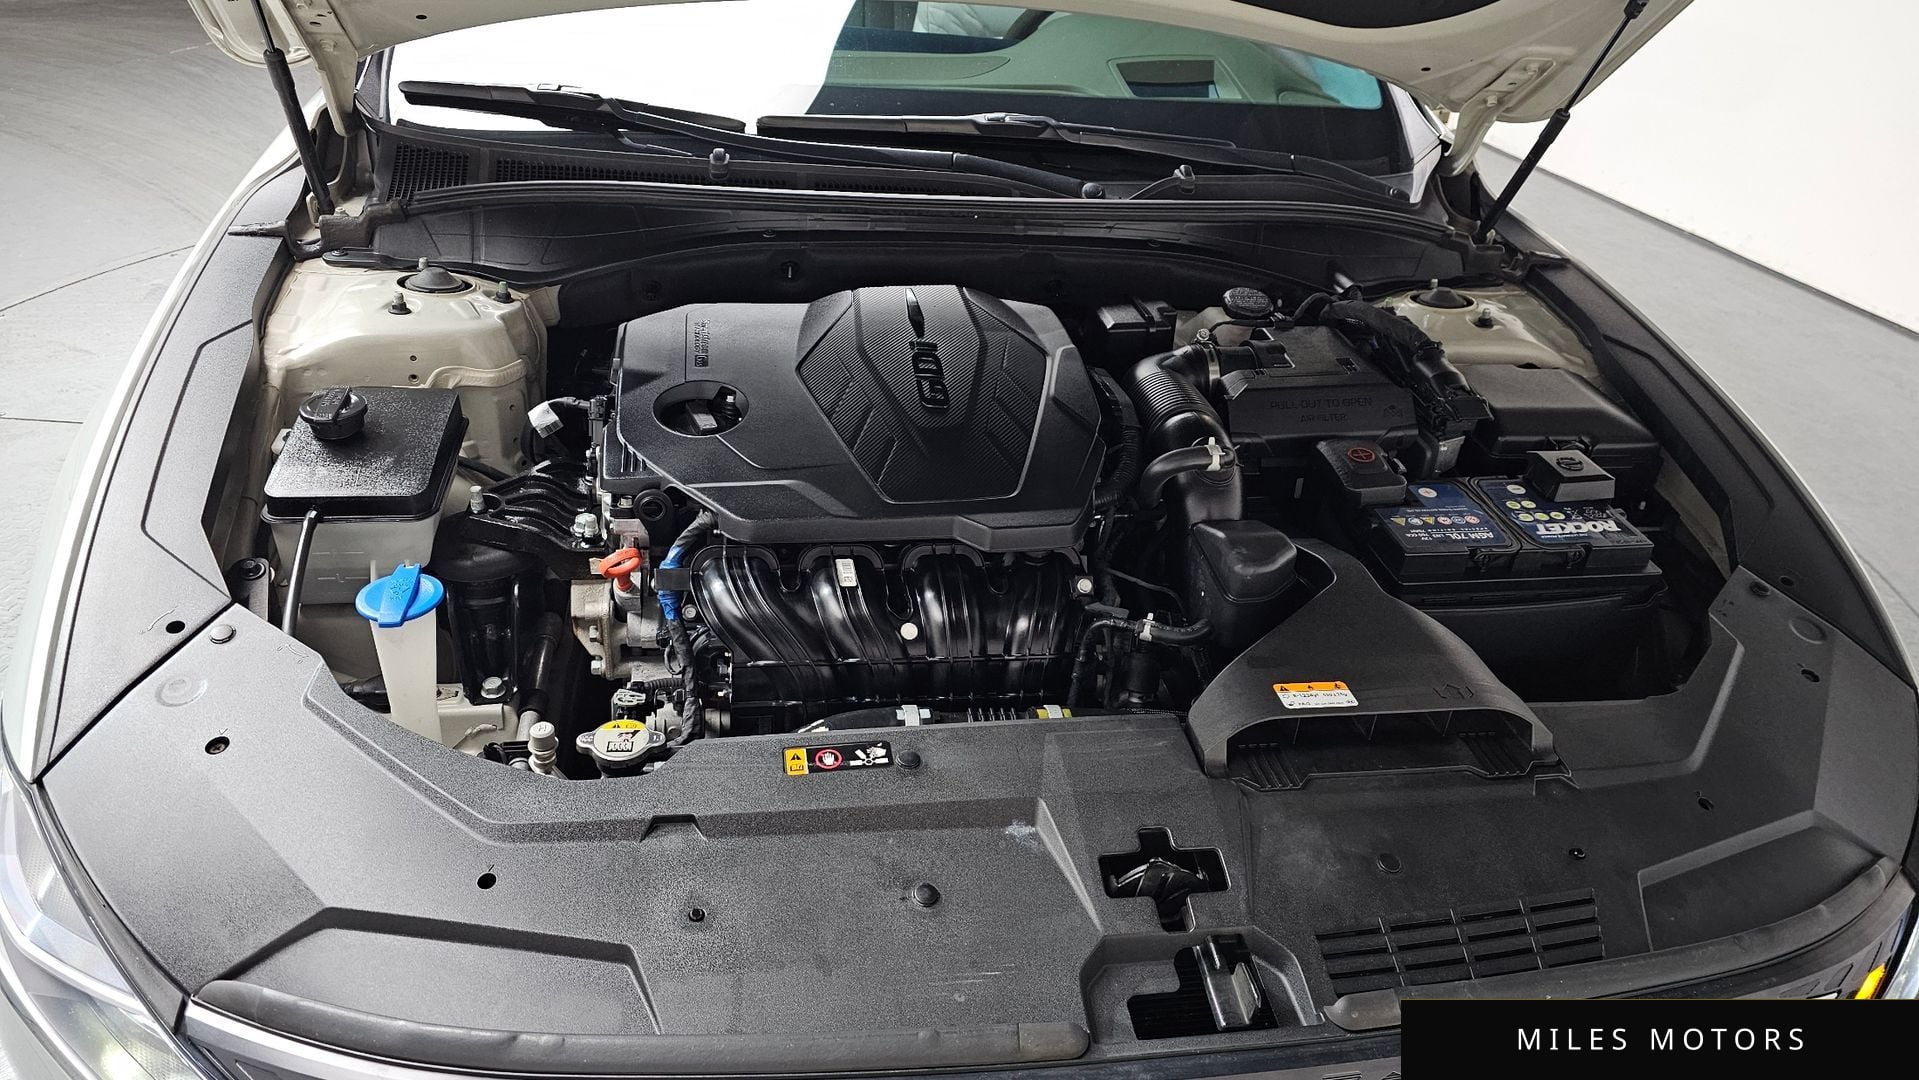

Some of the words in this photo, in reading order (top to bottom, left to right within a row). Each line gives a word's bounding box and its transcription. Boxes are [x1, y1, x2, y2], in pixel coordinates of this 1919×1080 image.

[1301, 399, 1321, 408] OUT
[1326, 398, 1340, 408] TO
[1342, 397, 1372, 407] OPEN
[1536, 520, 1621, 535] ROCKET
